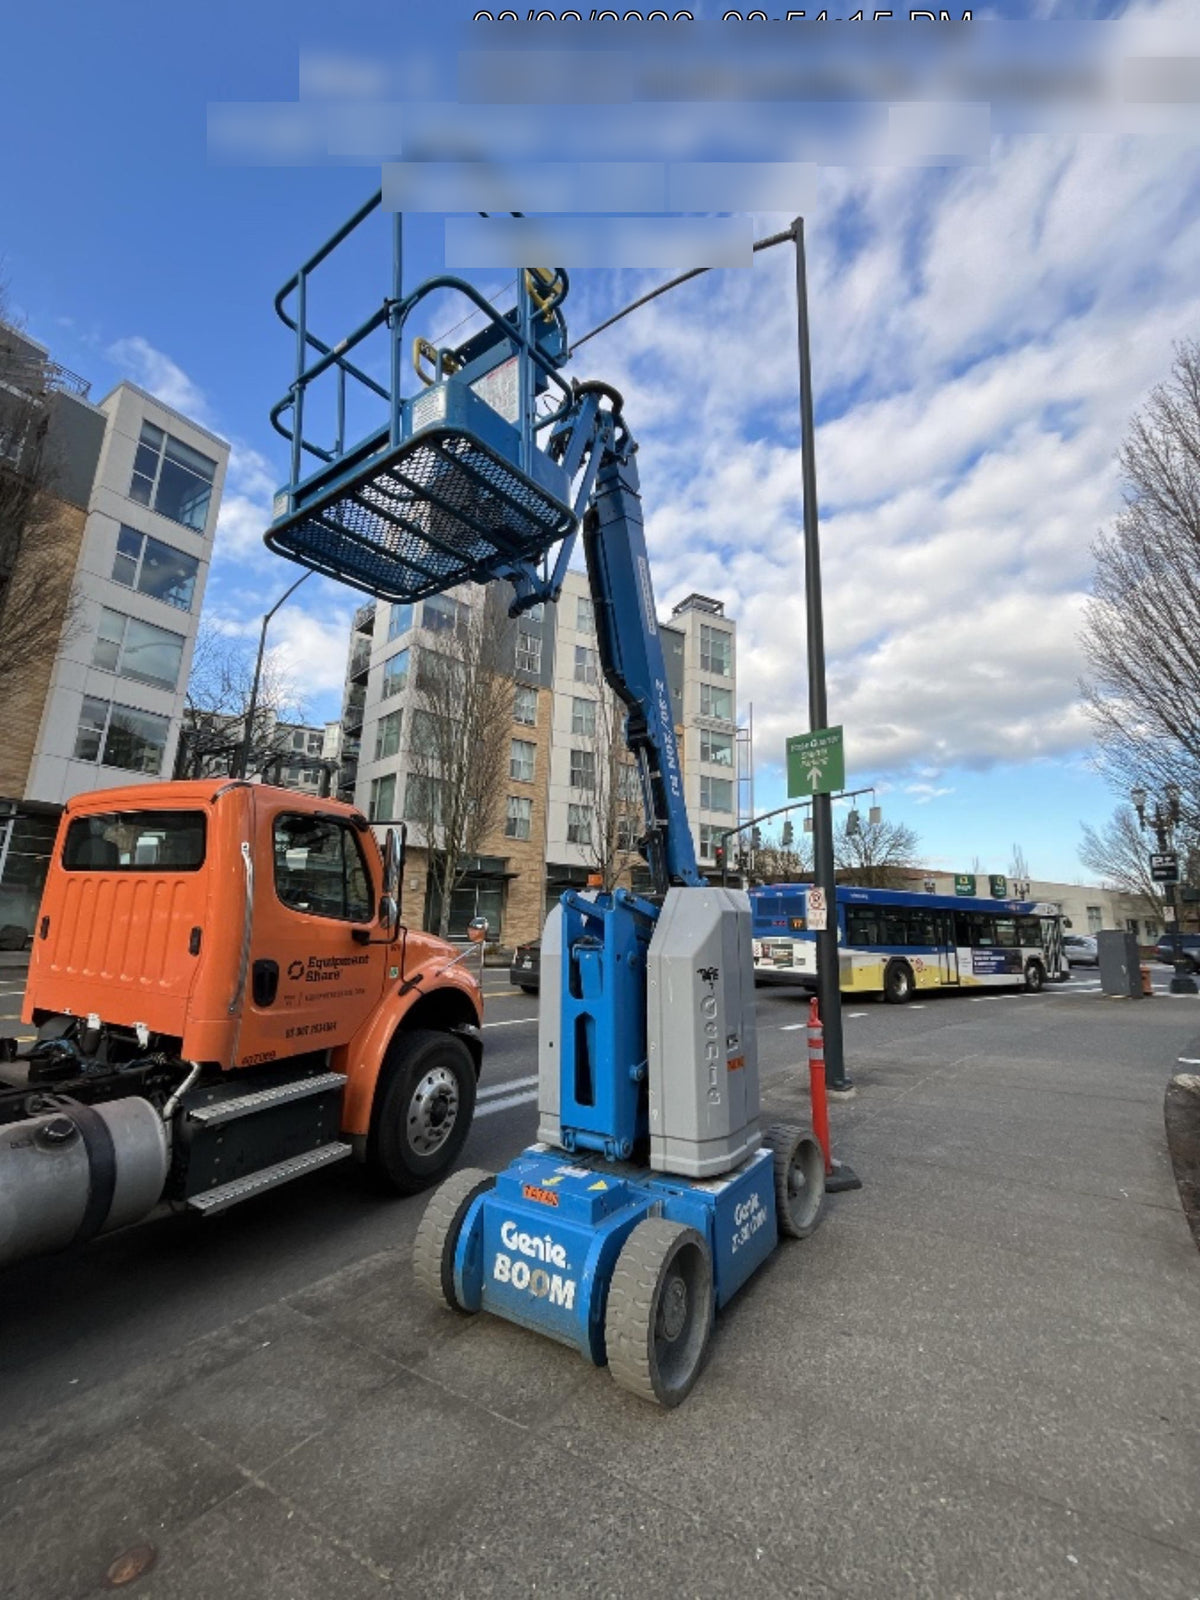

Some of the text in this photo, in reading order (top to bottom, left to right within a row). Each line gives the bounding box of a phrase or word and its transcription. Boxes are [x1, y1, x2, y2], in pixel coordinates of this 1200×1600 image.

[304, 969, 341, 983] Share
[307, 954, 370, 970] Equipment
[500, 1220, 567, 1270] Genie
[493, 1252, 576, 1310] BOOM
